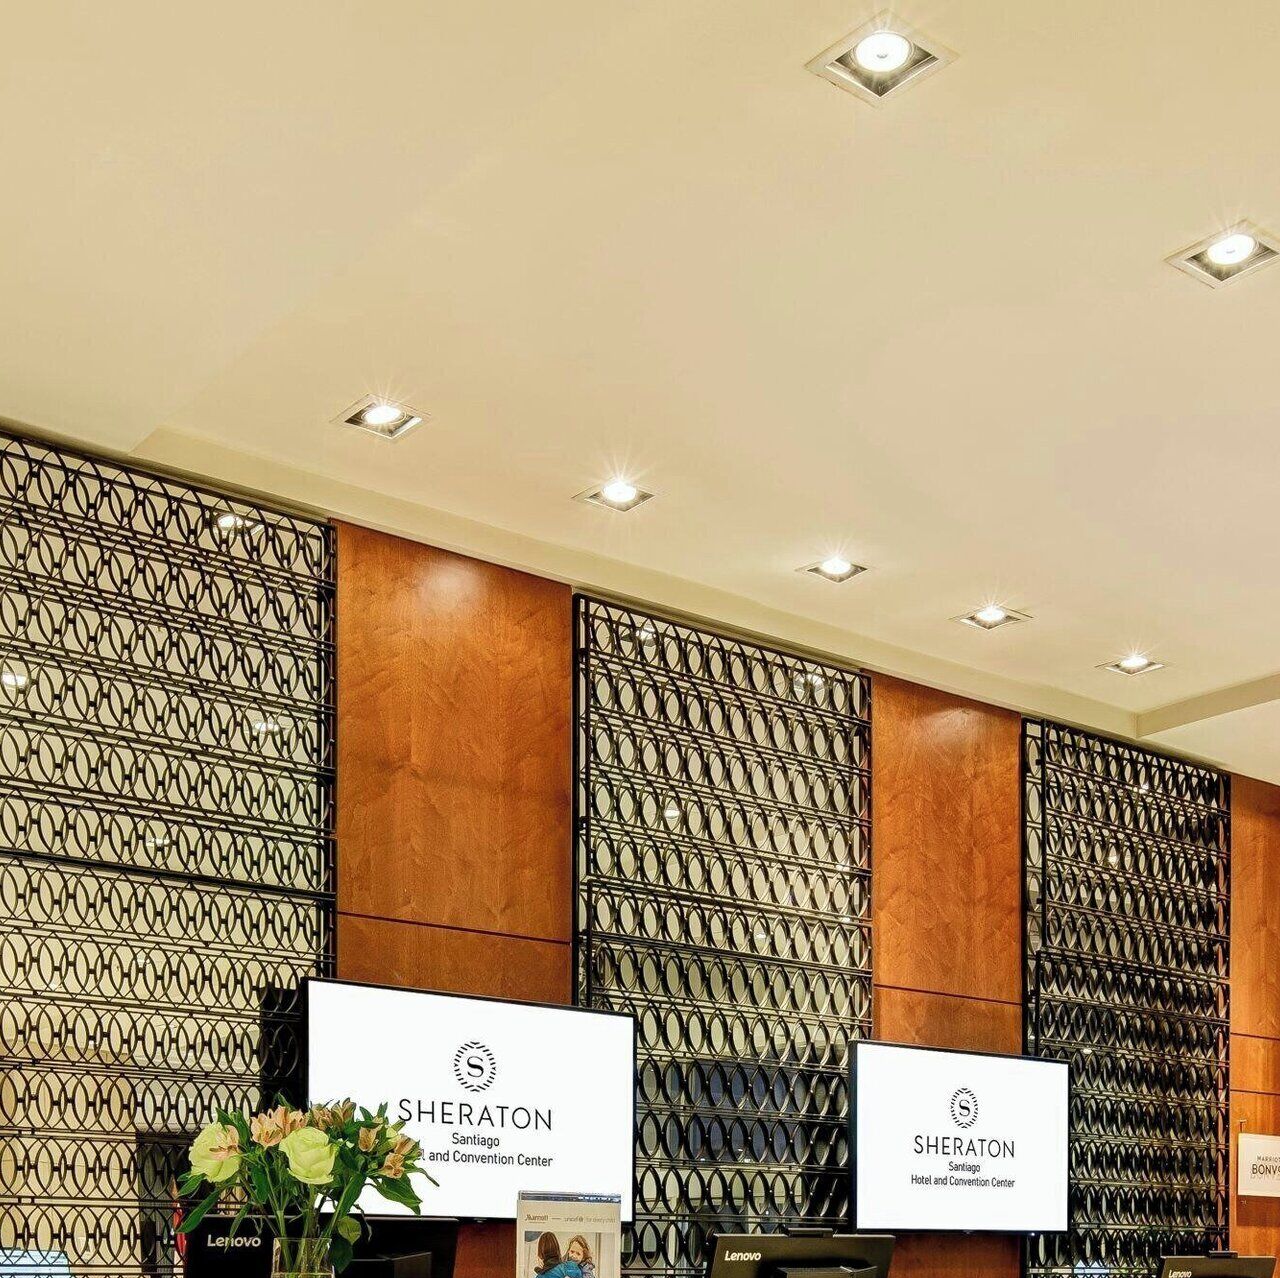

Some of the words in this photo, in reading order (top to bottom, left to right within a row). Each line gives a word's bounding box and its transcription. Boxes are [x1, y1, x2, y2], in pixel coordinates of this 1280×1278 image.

[466, 1056, 484, 1078] S
[398, 1098, 552, 1131] SHERATON
[958, 1099, 971, 1117] S
[451, 1132, 500, 1149] Santiago
[913, 1134, 1015, 1158] SHERATON
[428, 1150, 450, 1162] and
[452, 1150, 514, 1165] Convention
[517, 1153, 553, 1167] Center
[948, 1160, 980, 1175] Santiago
[910, 1174, 932, 1185] Hotel
[933, 1175, 948, 1186] and
[949, 1175, 990, 1187] Convention
[991, 1177, 1015, 1188] Center
[207, 1234, 262, 1247] Lenovo
[724, 1250, 762, 1262] Lenovo
[1168, 1269, 1192, 1278] Lenovo
